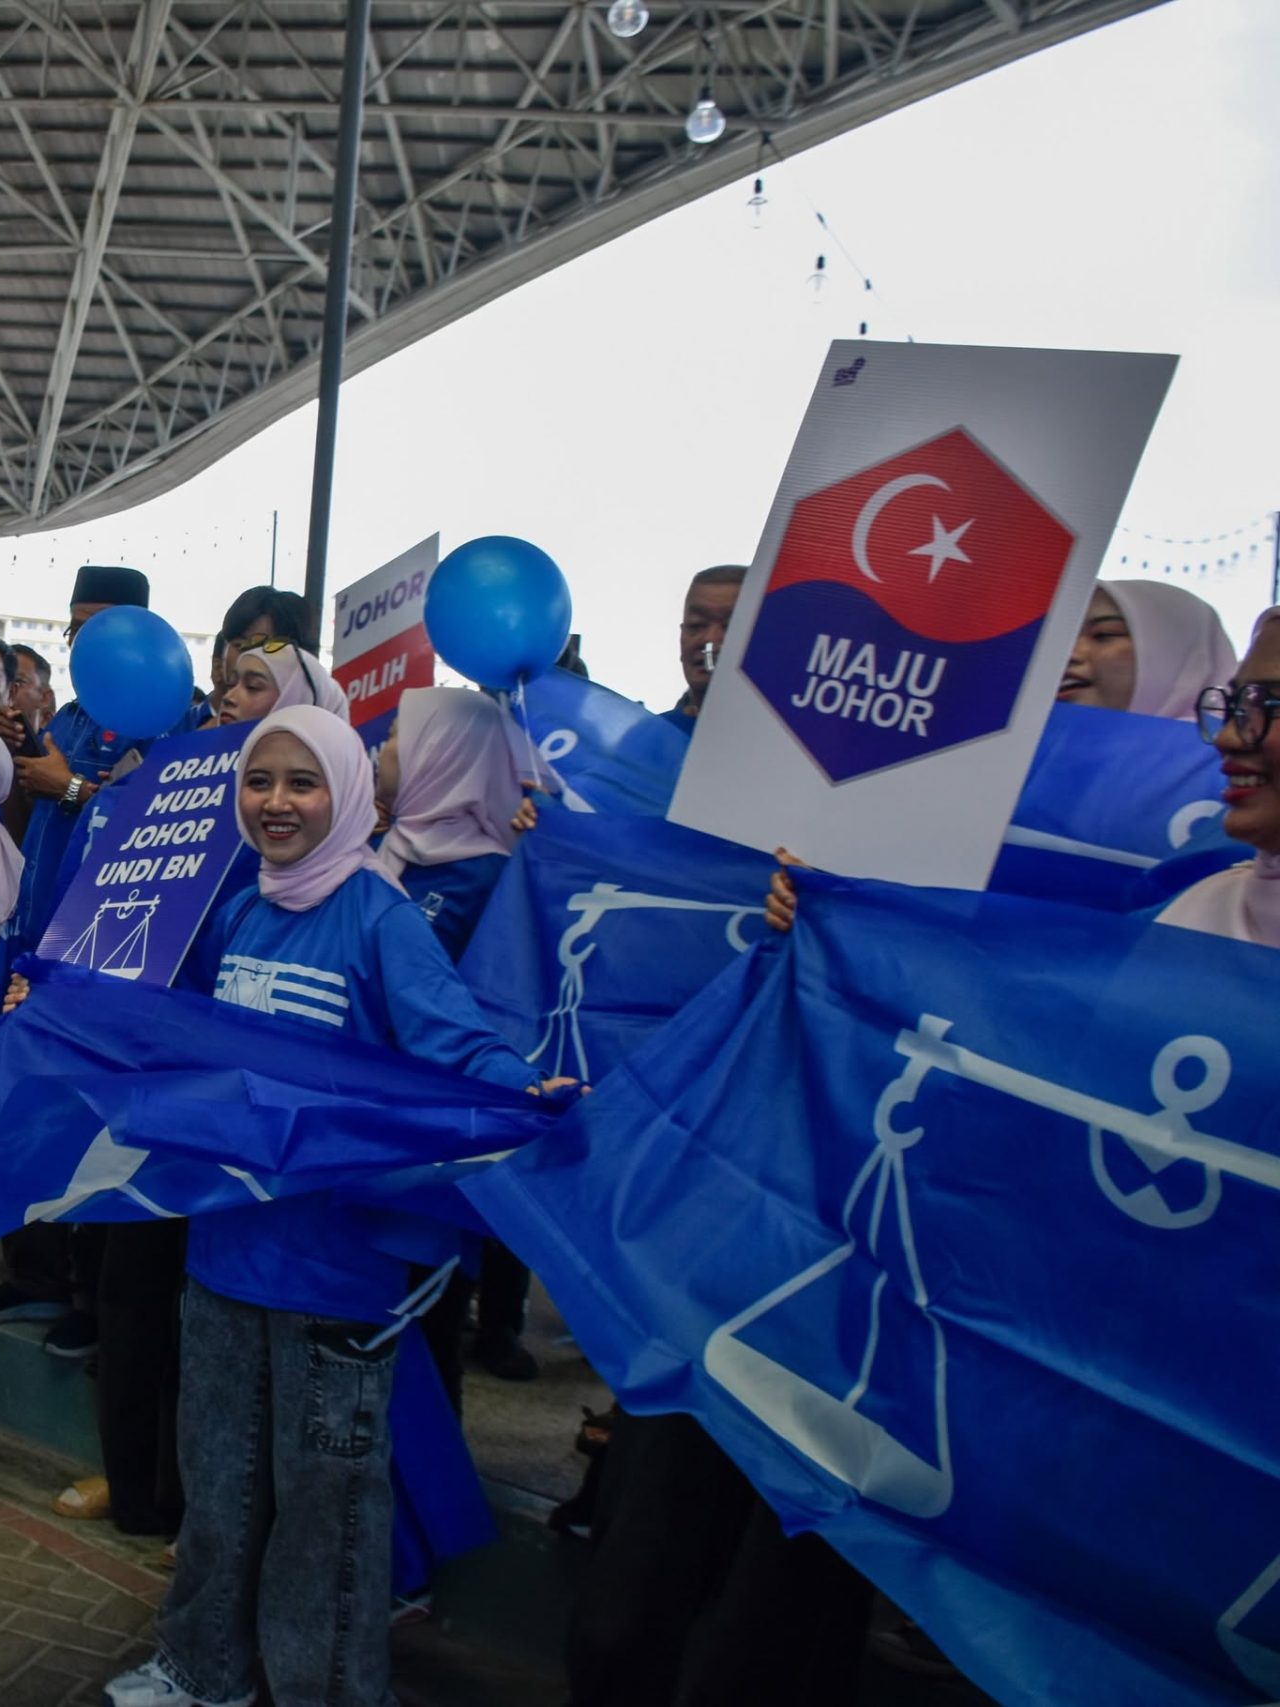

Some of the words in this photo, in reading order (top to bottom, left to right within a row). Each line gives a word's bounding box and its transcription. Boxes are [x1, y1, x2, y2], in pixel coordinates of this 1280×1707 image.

[342, 570, 425, 638] JOHOR
[347, 653, 409, 702] PILIH
[806, 634, 948, 698] MAJU
[791, 676, 935, 738] JOHOR
[145, 784, 226, 816] MUDA
[119, 818, 216, 851] JOHOR
[95, 857, 164, 886] UNDI
[160, 853, 207, 880] BN
